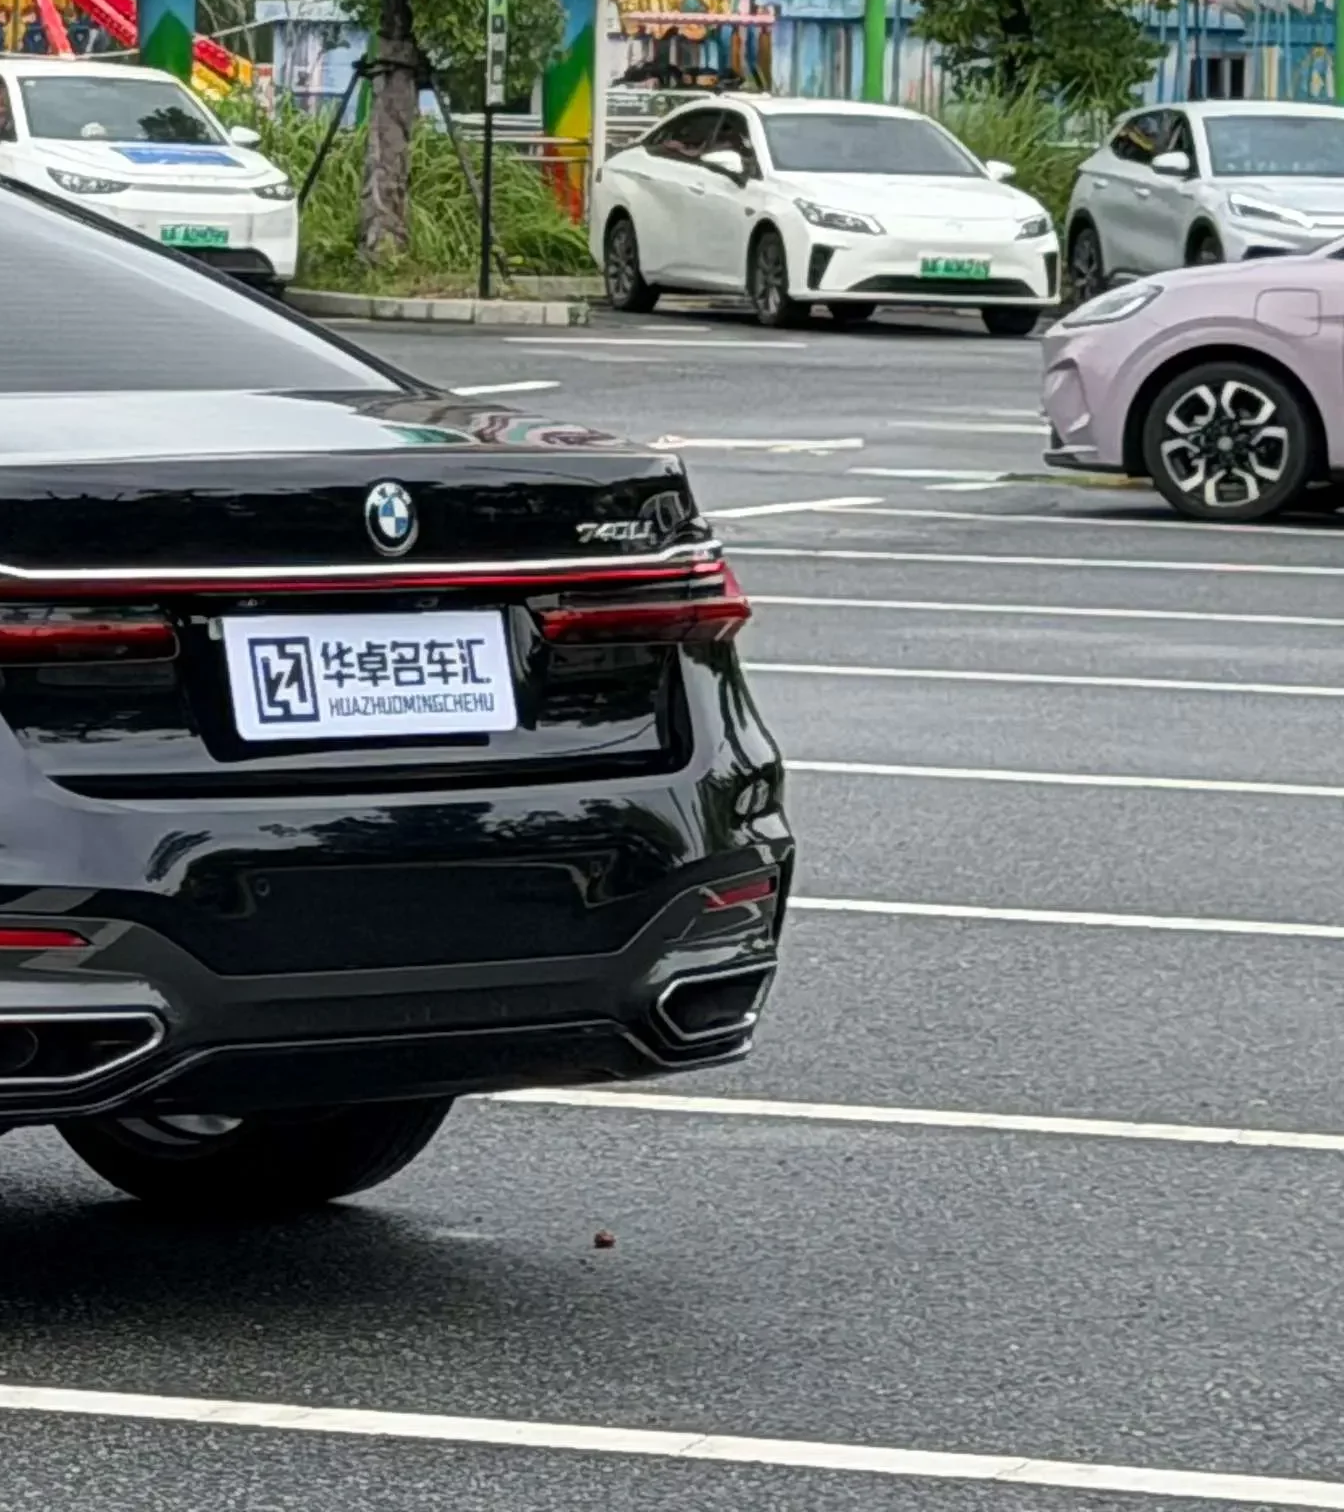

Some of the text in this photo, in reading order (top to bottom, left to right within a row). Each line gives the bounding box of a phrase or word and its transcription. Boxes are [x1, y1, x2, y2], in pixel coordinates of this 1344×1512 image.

[320, 639, 492, 689] 华卓名车汇
